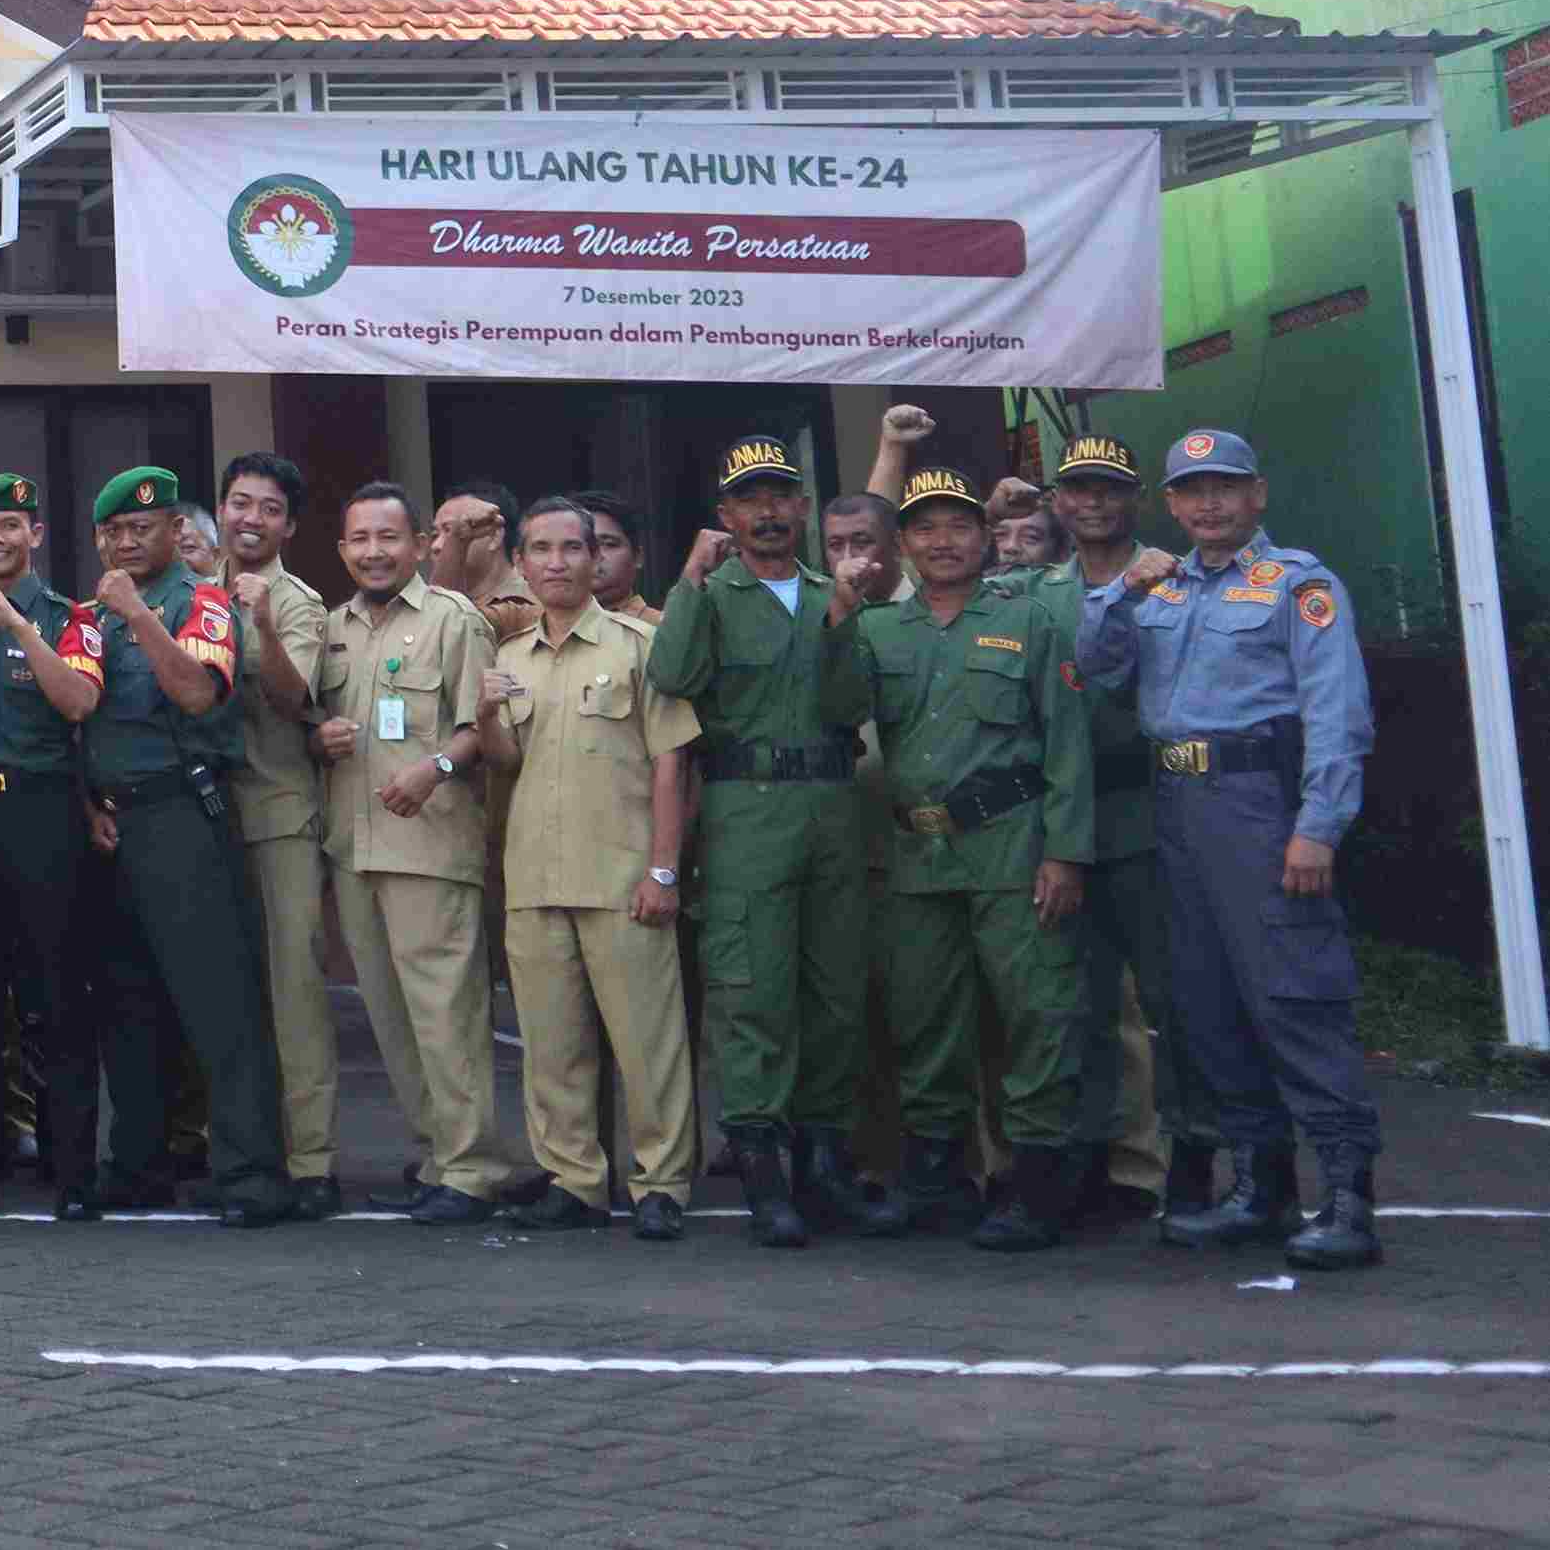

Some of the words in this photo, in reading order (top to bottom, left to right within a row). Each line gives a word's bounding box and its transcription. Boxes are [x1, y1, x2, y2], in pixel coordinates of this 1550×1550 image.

[381, 148, 476, 181] HARI
[488, 149, 627, 183] ULANG
[637, 151, 777, 186] TAHUN
[789, 155, 909, 188] KE-24
[429, 220, 564, 255] Dharma
[573, 224, 692, 258] Wanita
[706, 224, 871, 262] Persatuan
[563, 286, 575, 303] 7
[581, 286, 682, 305] Desember
[690, 289, 744, 306] 2023
[275, 316, 347, 337] Peran
[355, 319, 459, 344] Strategis
[466, 320, 602, 346] Perempuan
[609, 322, 683, 344] dalam
[690, 324, 861, 351] Pembangunan
[867, 328, 1025, 354] Berkelanjutan
[726, 442, 786, 475] LINMAS
[1065, 437, 1128, 466] LINMAS
[904, 470, 967, 500] LINMAS
